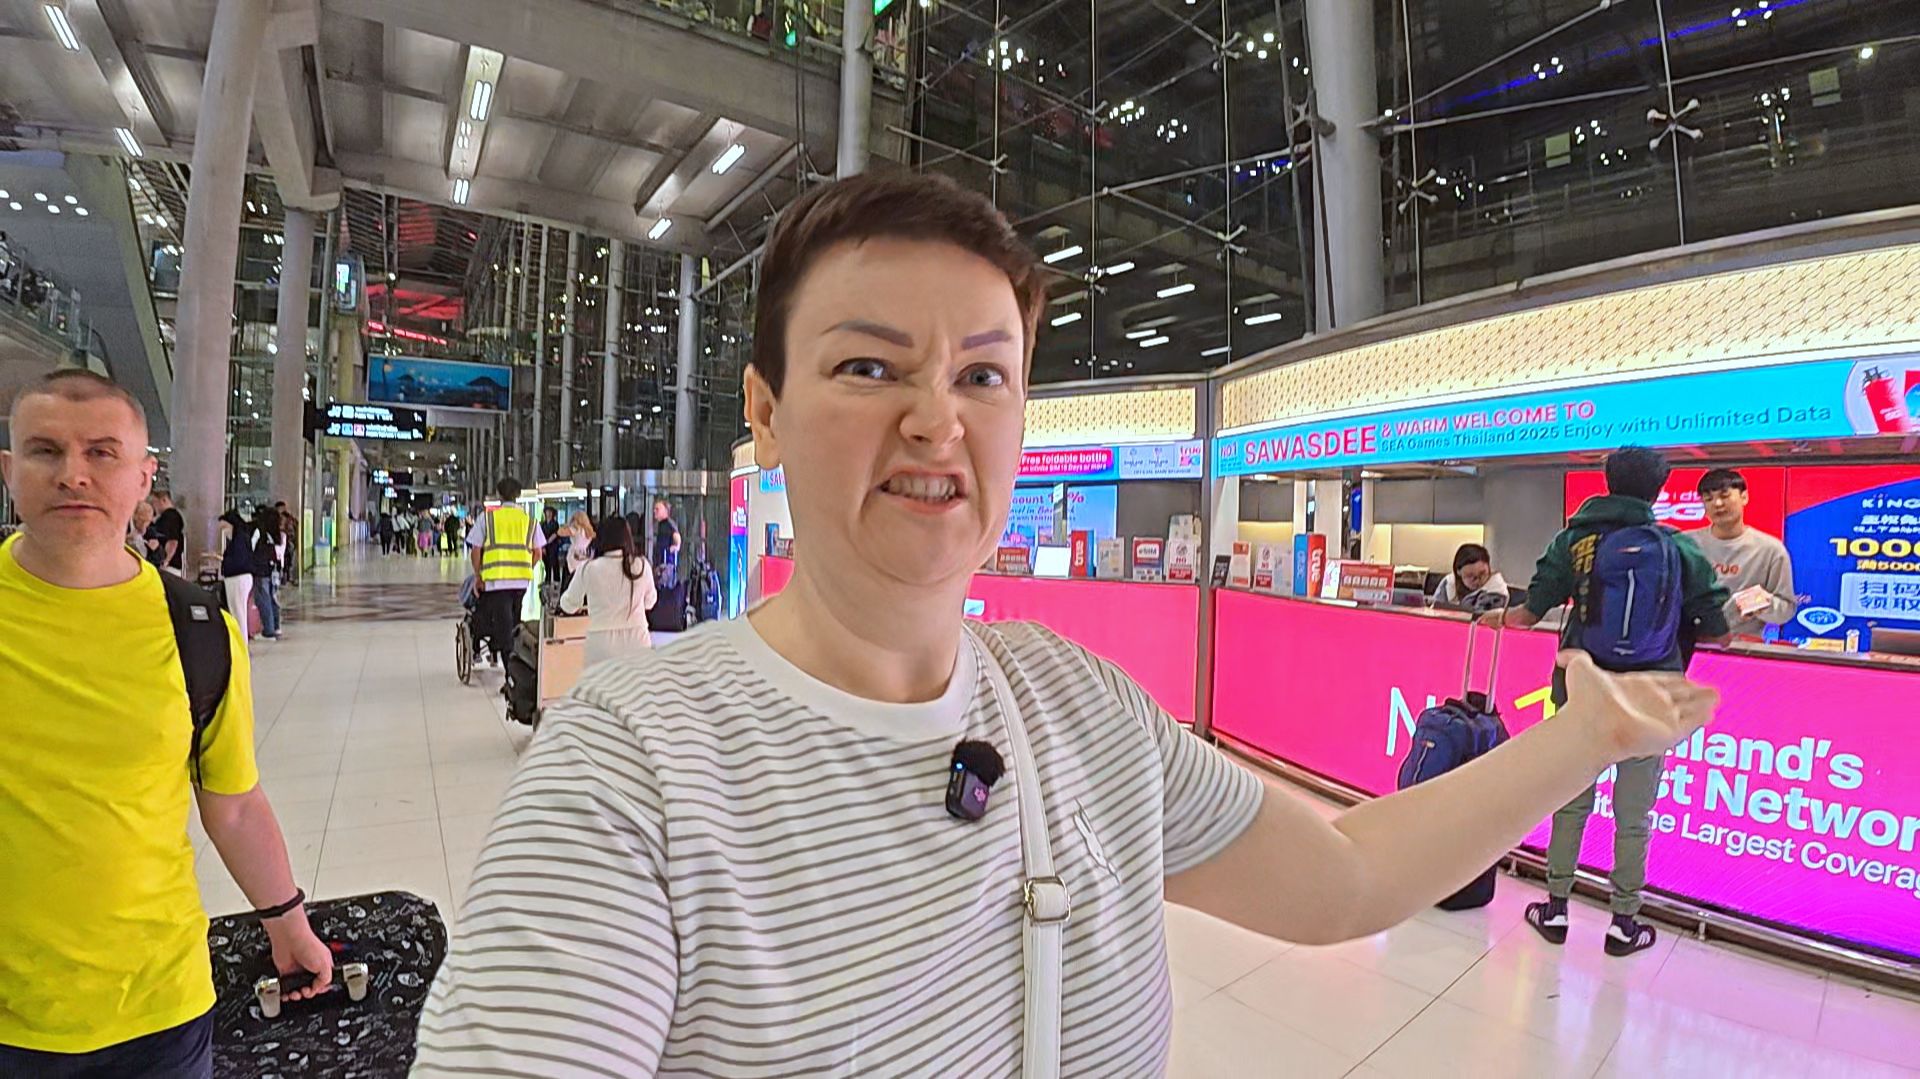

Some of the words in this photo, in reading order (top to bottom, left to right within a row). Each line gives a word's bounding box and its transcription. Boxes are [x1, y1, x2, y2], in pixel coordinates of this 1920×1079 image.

[1246, 425, 1376, 464] SAWASDEE
[1381, 423, 1391, 437] &
[1396, 417, 1448, 436] WARM
[1453, 405, 1557, 430] WELCOME
[1562, 401, 1594, 419] TO
[1407, 436, 1450, 450] Games
[1453, 428, 1515, 446] Thailand
[1518, 424, 1559, 441] 2025
[1564, 420, 1614, 440] Enjoy
[1619, 417, 1660, 434] with
[1665, 408, 1771, 431] Unlimited
[1776, 403, 1832, 425] Data
[1042, 453, 1078, 464] foldable
[1080, 452, 1108, 463] bottle
[1311, 548, 1323, 583] true
[1704, 768, 1920, 851] Networ
[1681, 812, 1796, 863] Largest
